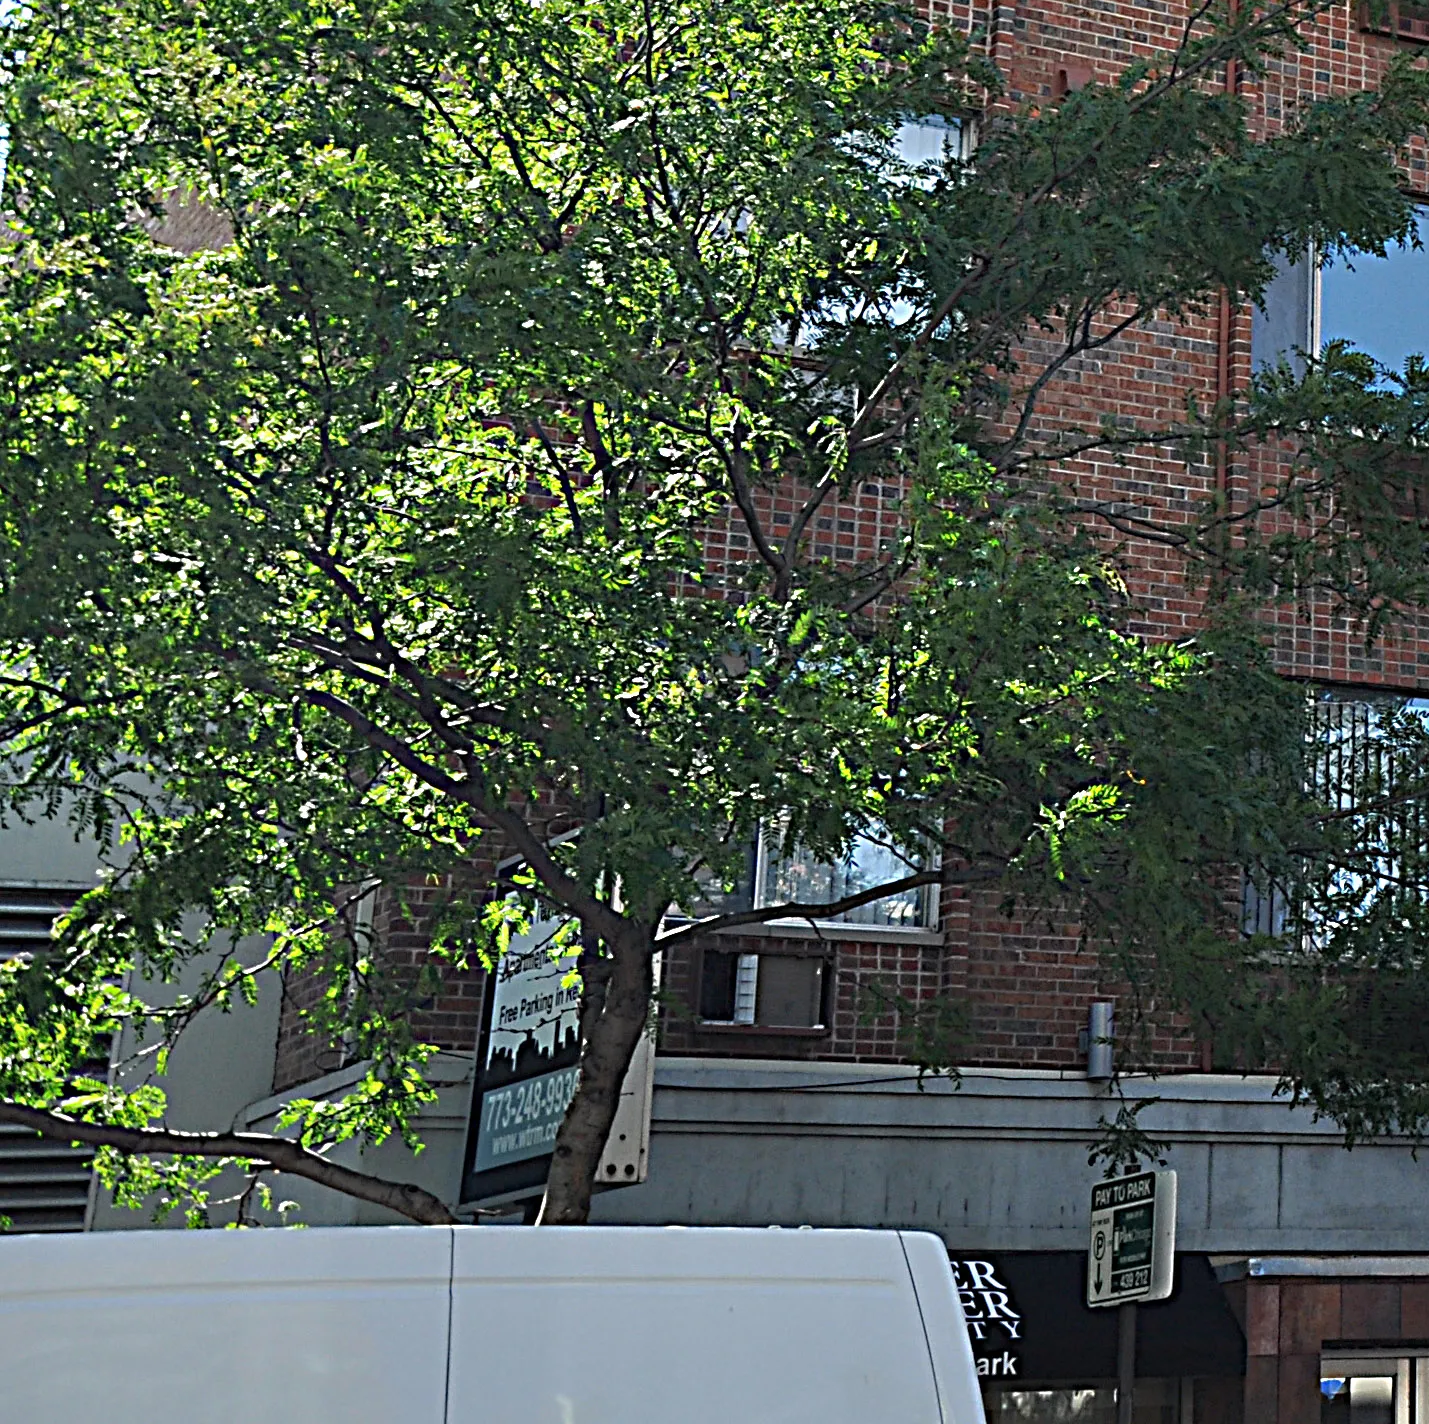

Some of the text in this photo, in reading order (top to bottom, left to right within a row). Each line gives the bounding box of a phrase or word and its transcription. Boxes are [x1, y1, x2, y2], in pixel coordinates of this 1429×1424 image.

[500, 1004, 518, 1025] Free
[520, 992, 553, 1019] Parking
[1095, 1179, 1151, 1206] PAY TO PARK
[977, 1351, 1017, 1375] ark
